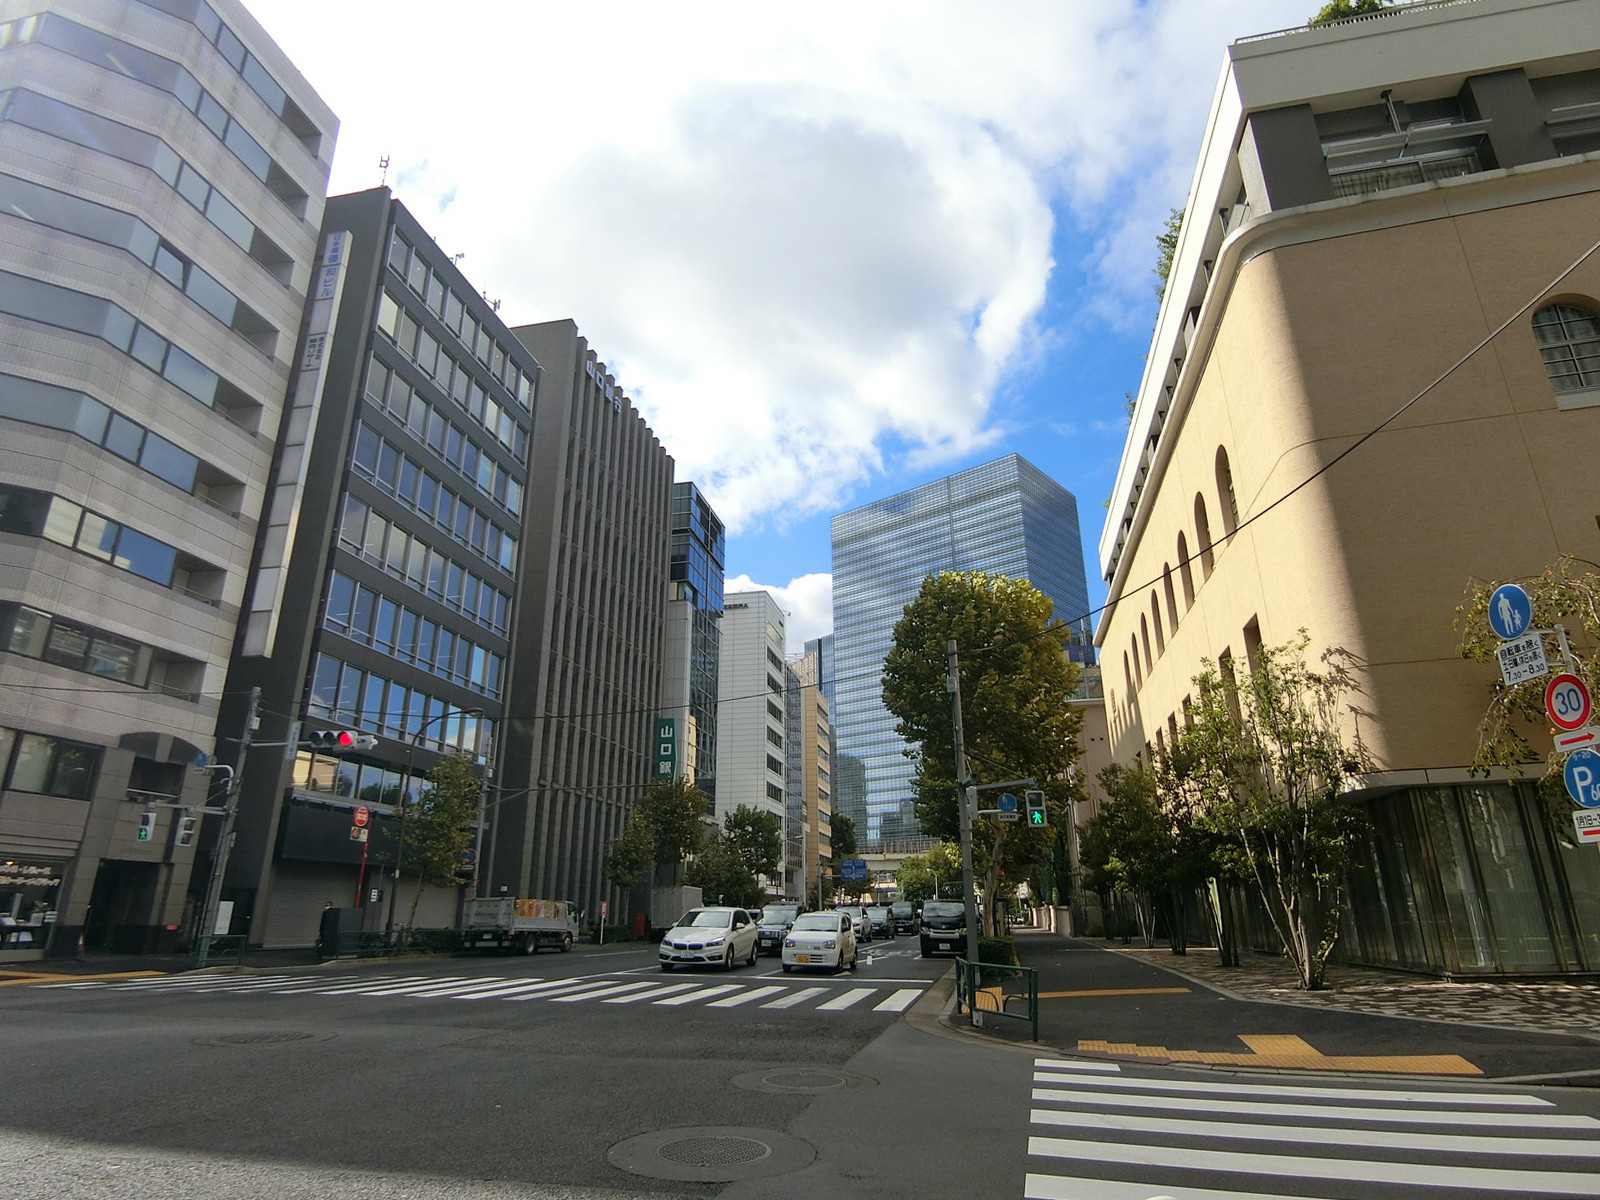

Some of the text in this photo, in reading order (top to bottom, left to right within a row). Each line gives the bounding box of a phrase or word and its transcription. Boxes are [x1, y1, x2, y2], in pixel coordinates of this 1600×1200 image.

[1500, 639, 1540, 660] 自転車を除く
[1554, 688, 1581, 716] 30
[658, 725, 674, 783] 山口銀
[1572, 766, 1593, 803] P
